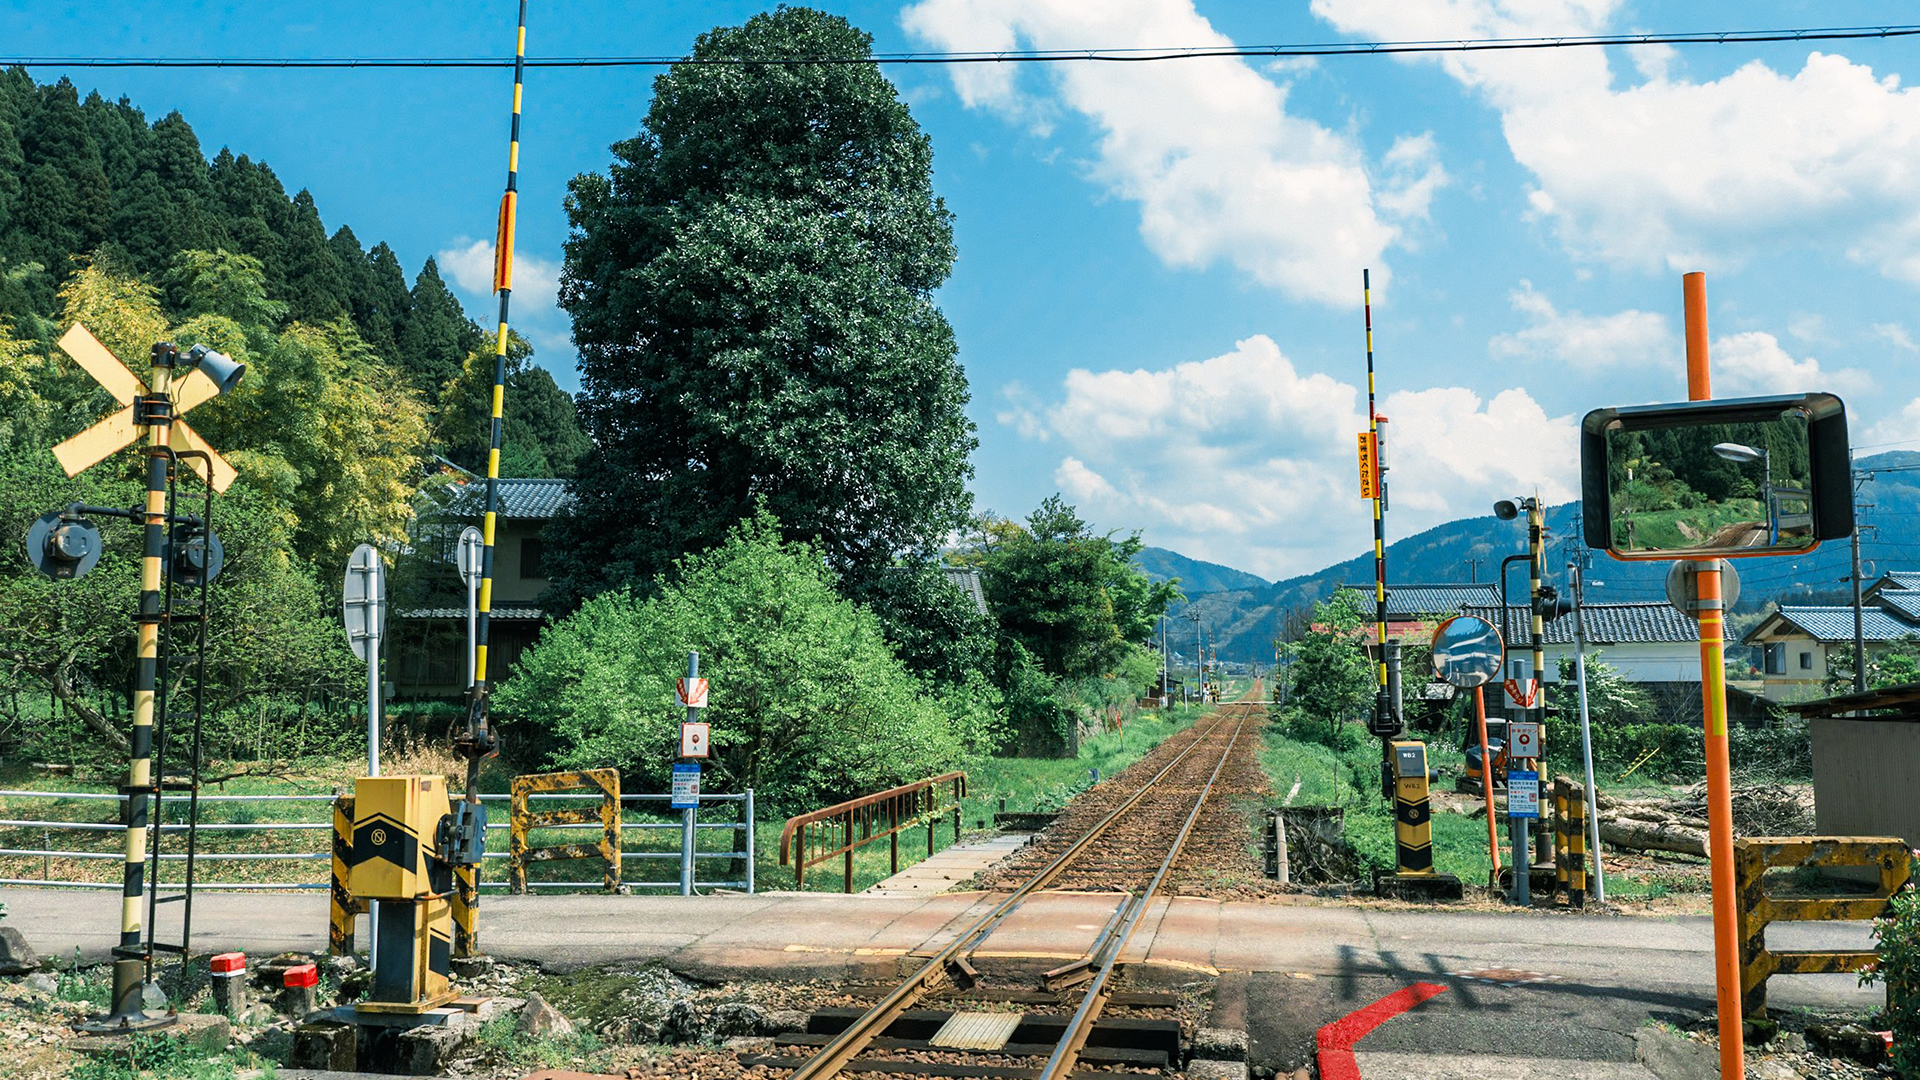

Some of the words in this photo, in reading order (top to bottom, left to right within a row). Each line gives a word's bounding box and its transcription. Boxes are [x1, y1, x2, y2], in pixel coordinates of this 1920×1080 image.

[1360, 436, 1370, 496] おまちください
